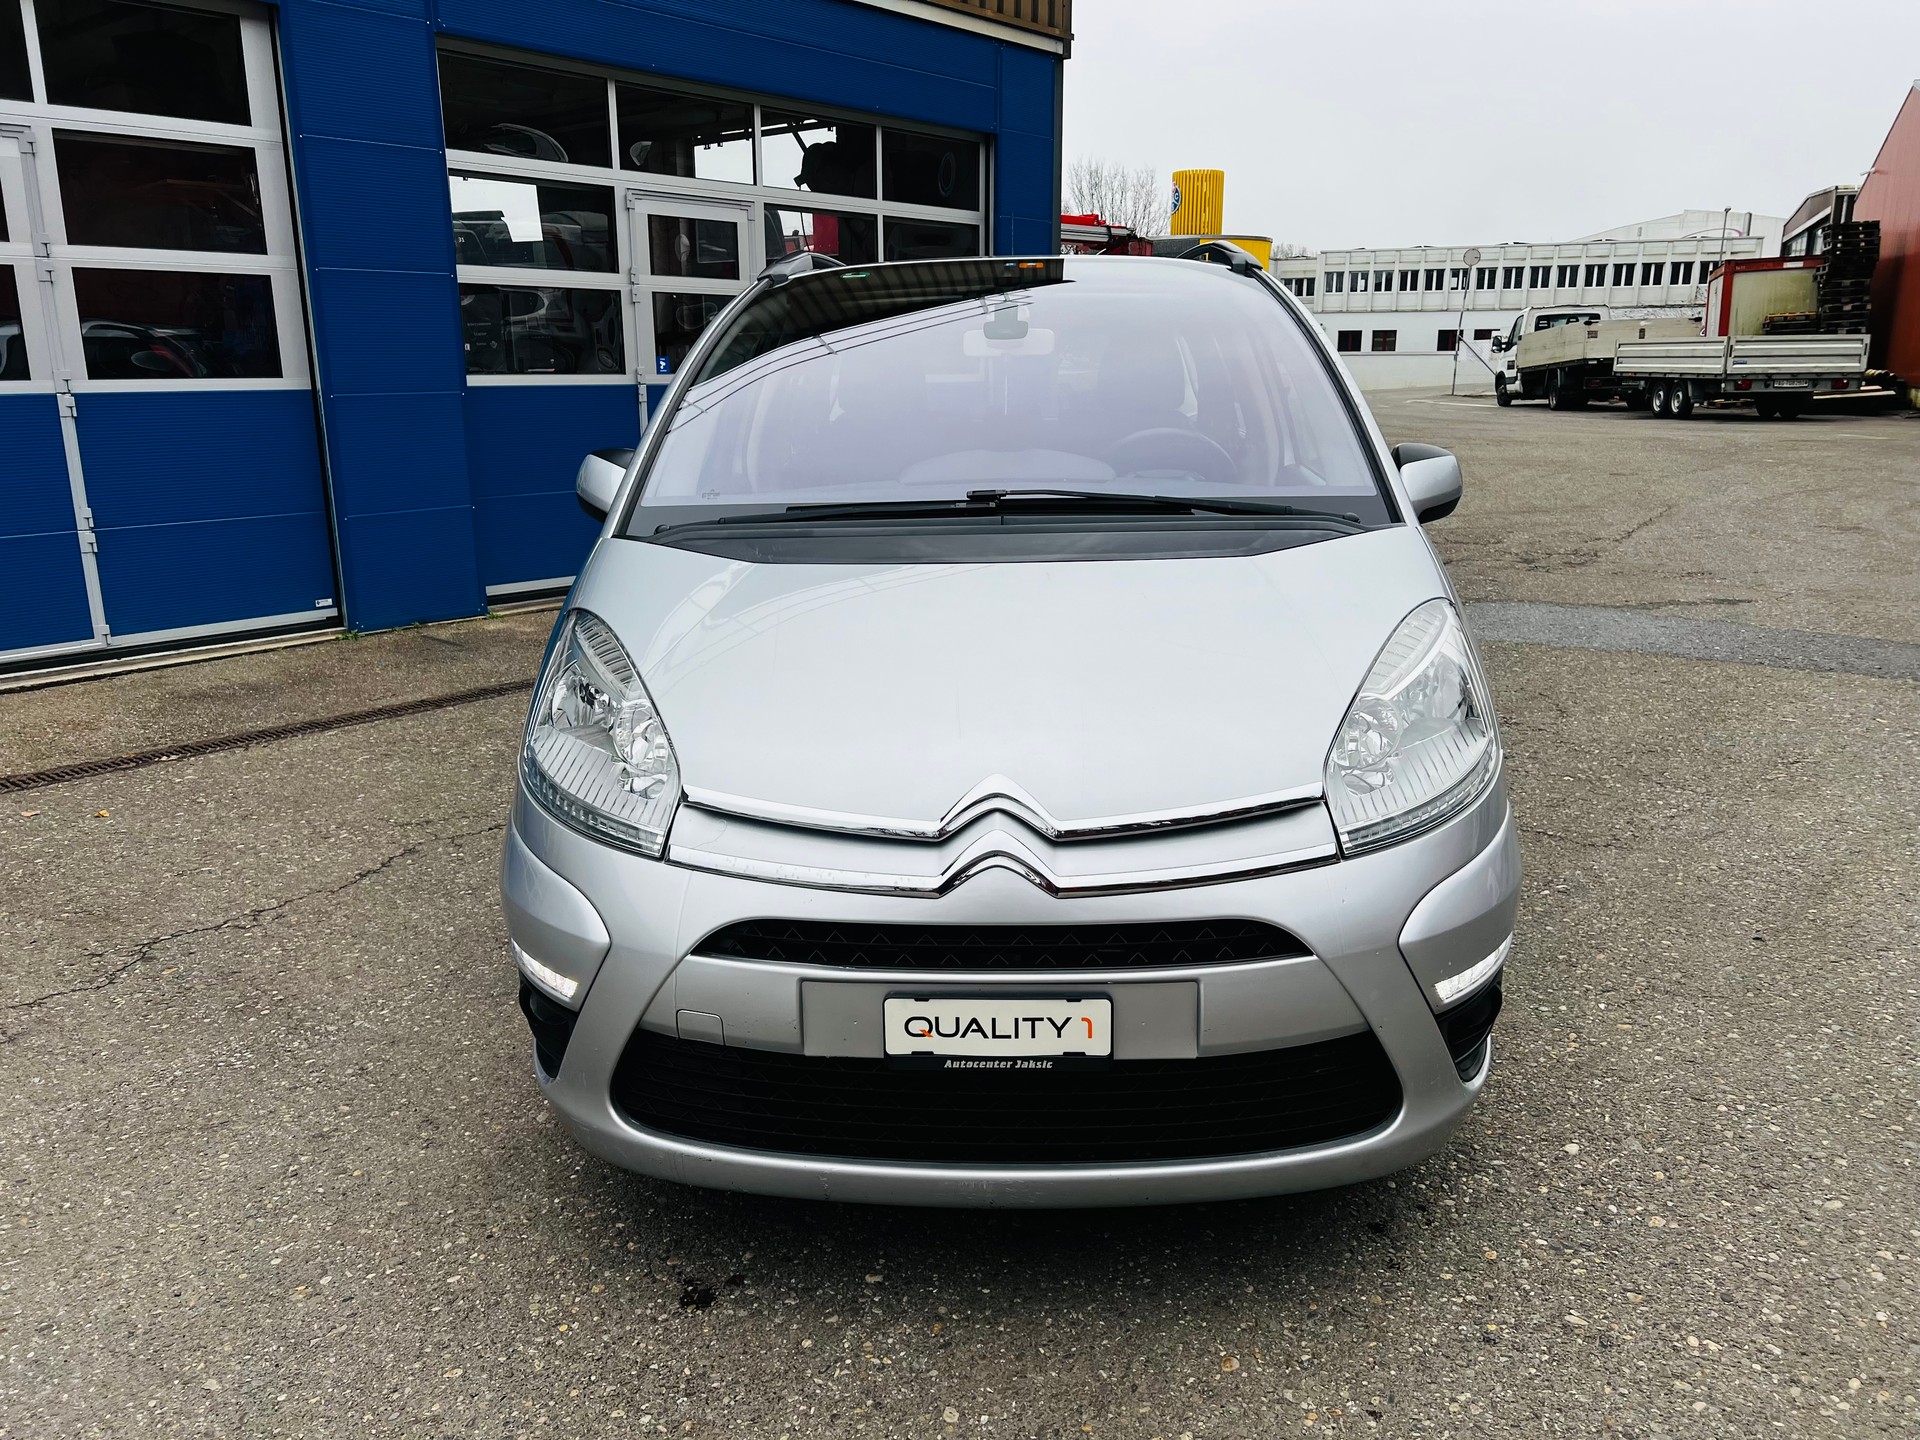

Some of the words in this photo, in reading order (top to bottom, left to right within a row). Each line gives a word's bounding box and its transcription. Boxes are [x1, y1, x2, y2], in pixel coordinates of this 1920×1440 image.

[904, 1016, 1072, 1039] QUALITY
[1080, 1017, 1093, 1039] 1
[944, 1059, 1012, 1069] Autocenter
[1015, 1059, 1053, 1070] Jaksic
